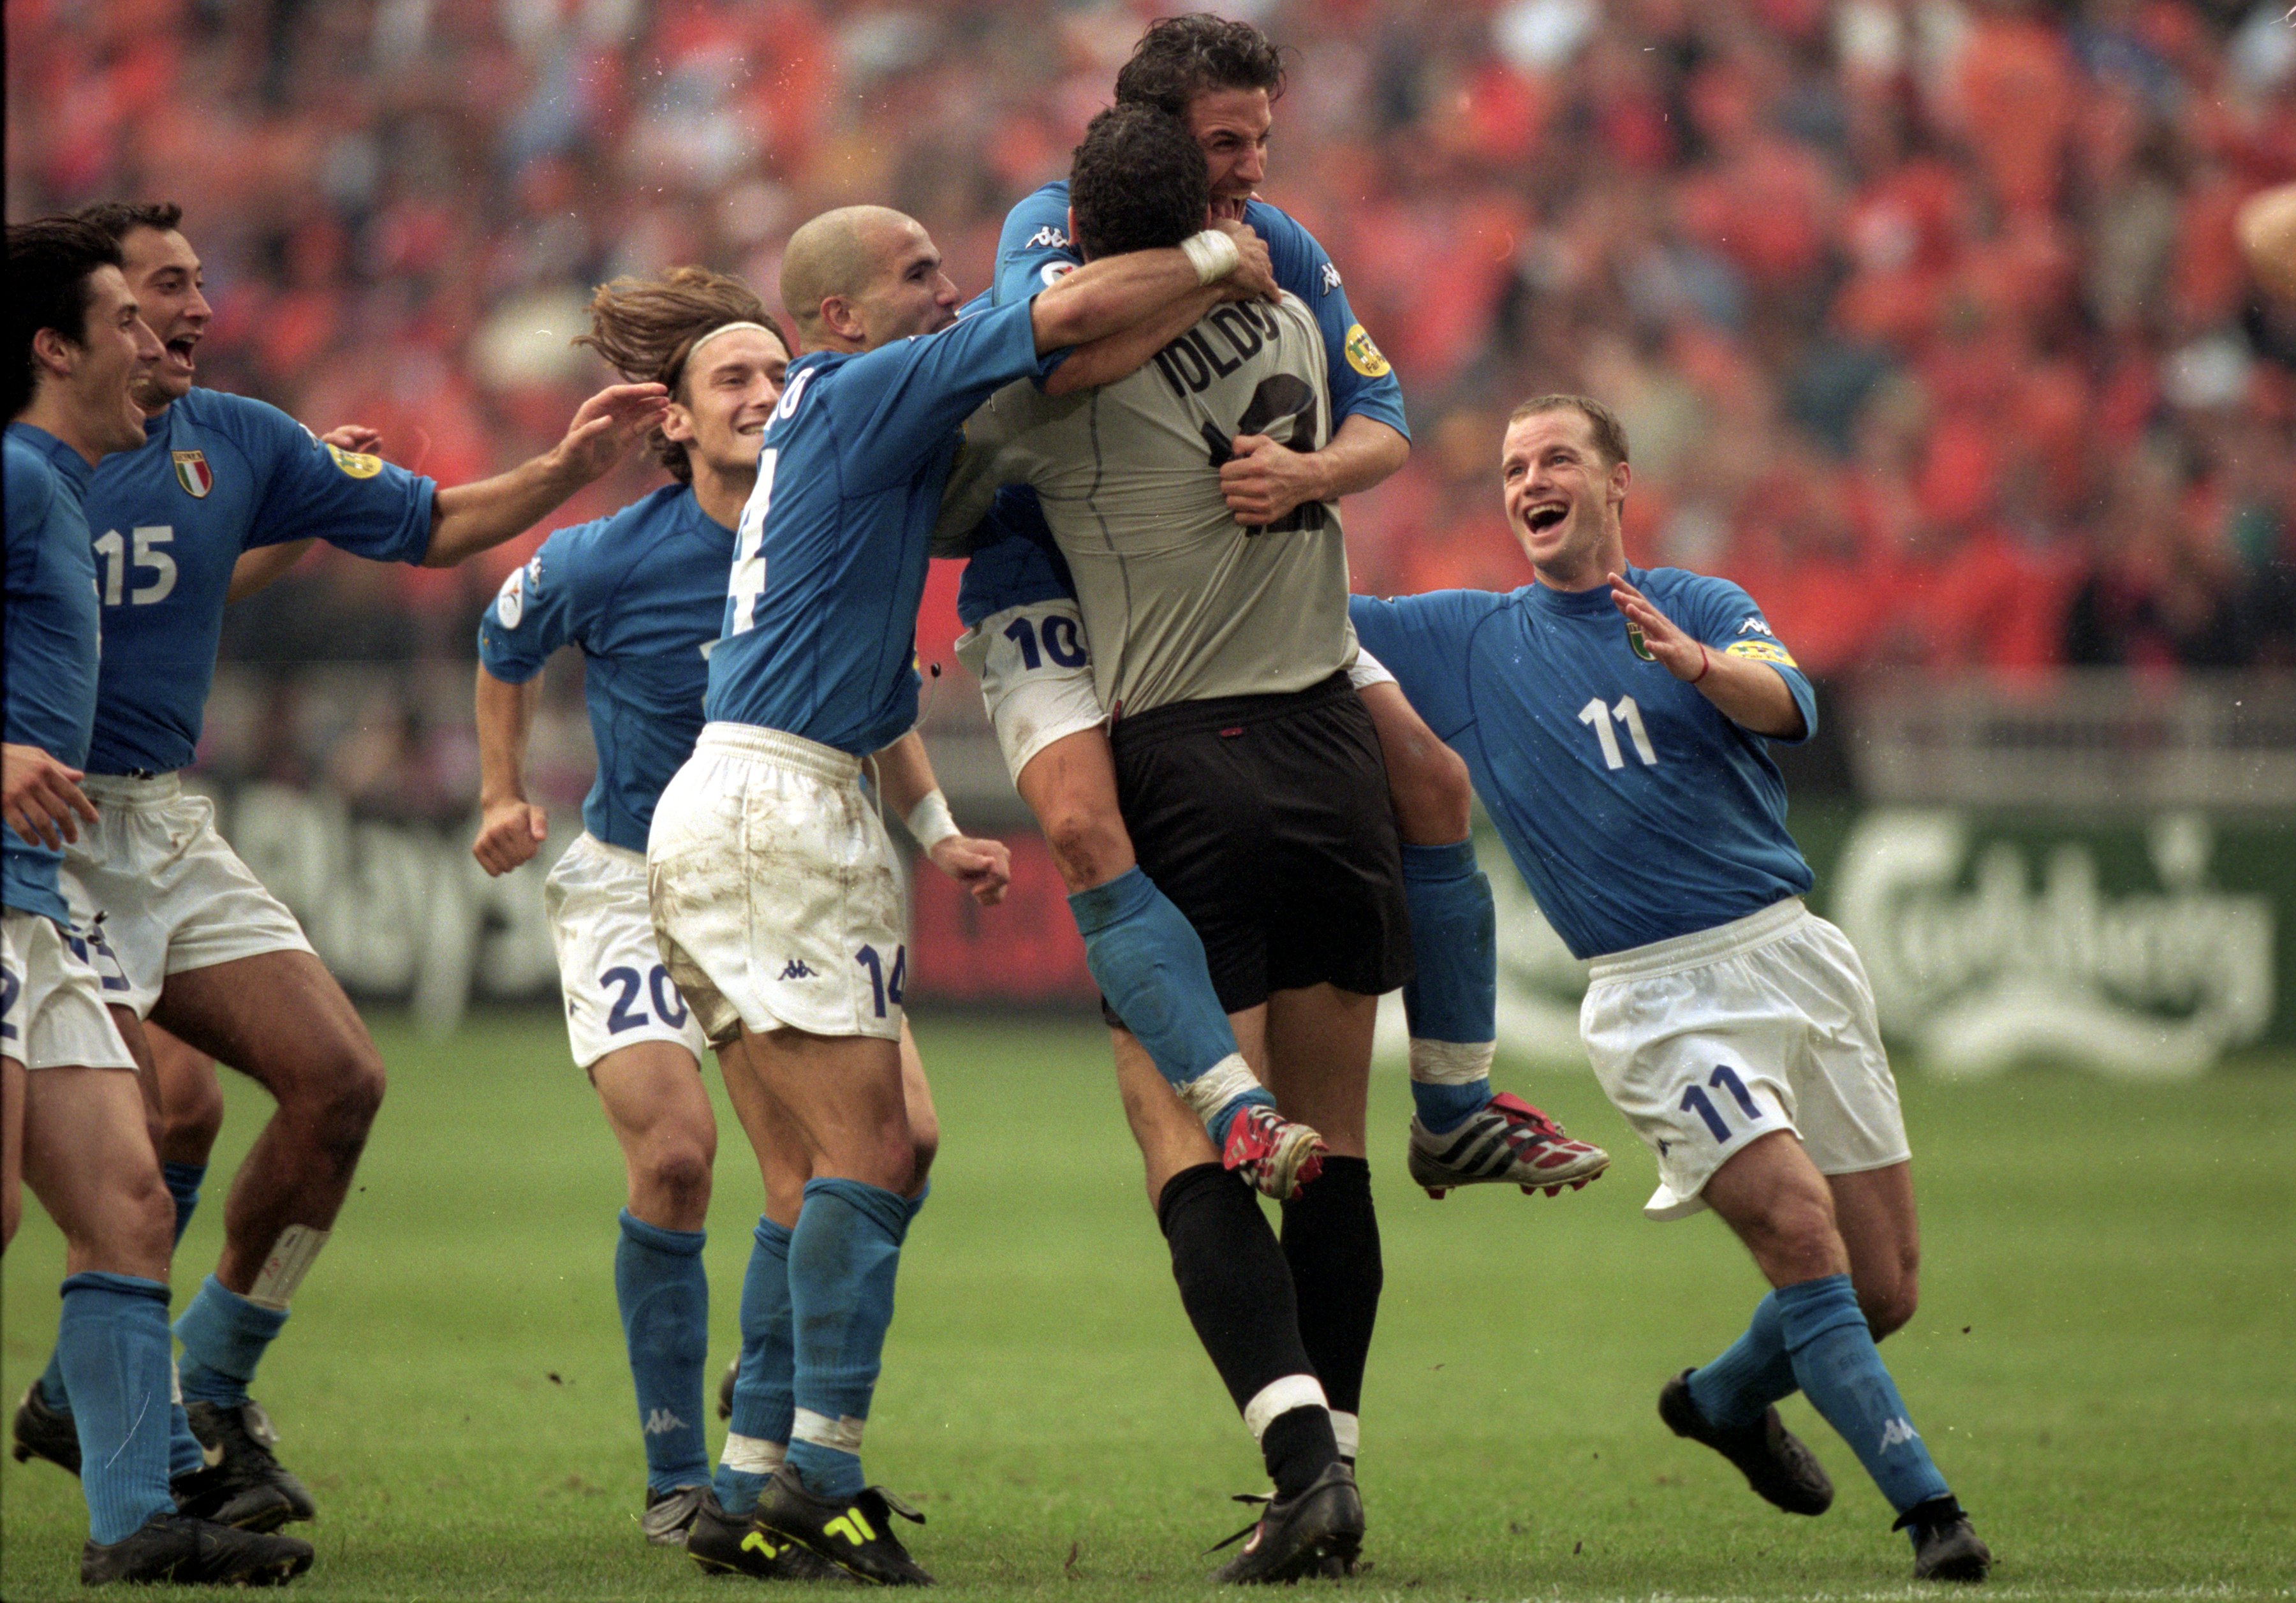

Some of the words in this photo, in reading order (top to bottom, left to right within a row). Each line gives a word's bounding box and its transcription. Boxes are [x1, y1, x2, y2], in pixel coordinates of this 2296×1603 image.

[93, 526, 178, 606] 15
[1003, 615, 1087, 670] 10
[1578, 695, 1658, 770] 11
[599, 963, 688, 1035] 20
[855, 944, 906, 1018] 14
[1679, 1064, 1763, 1144] 11
